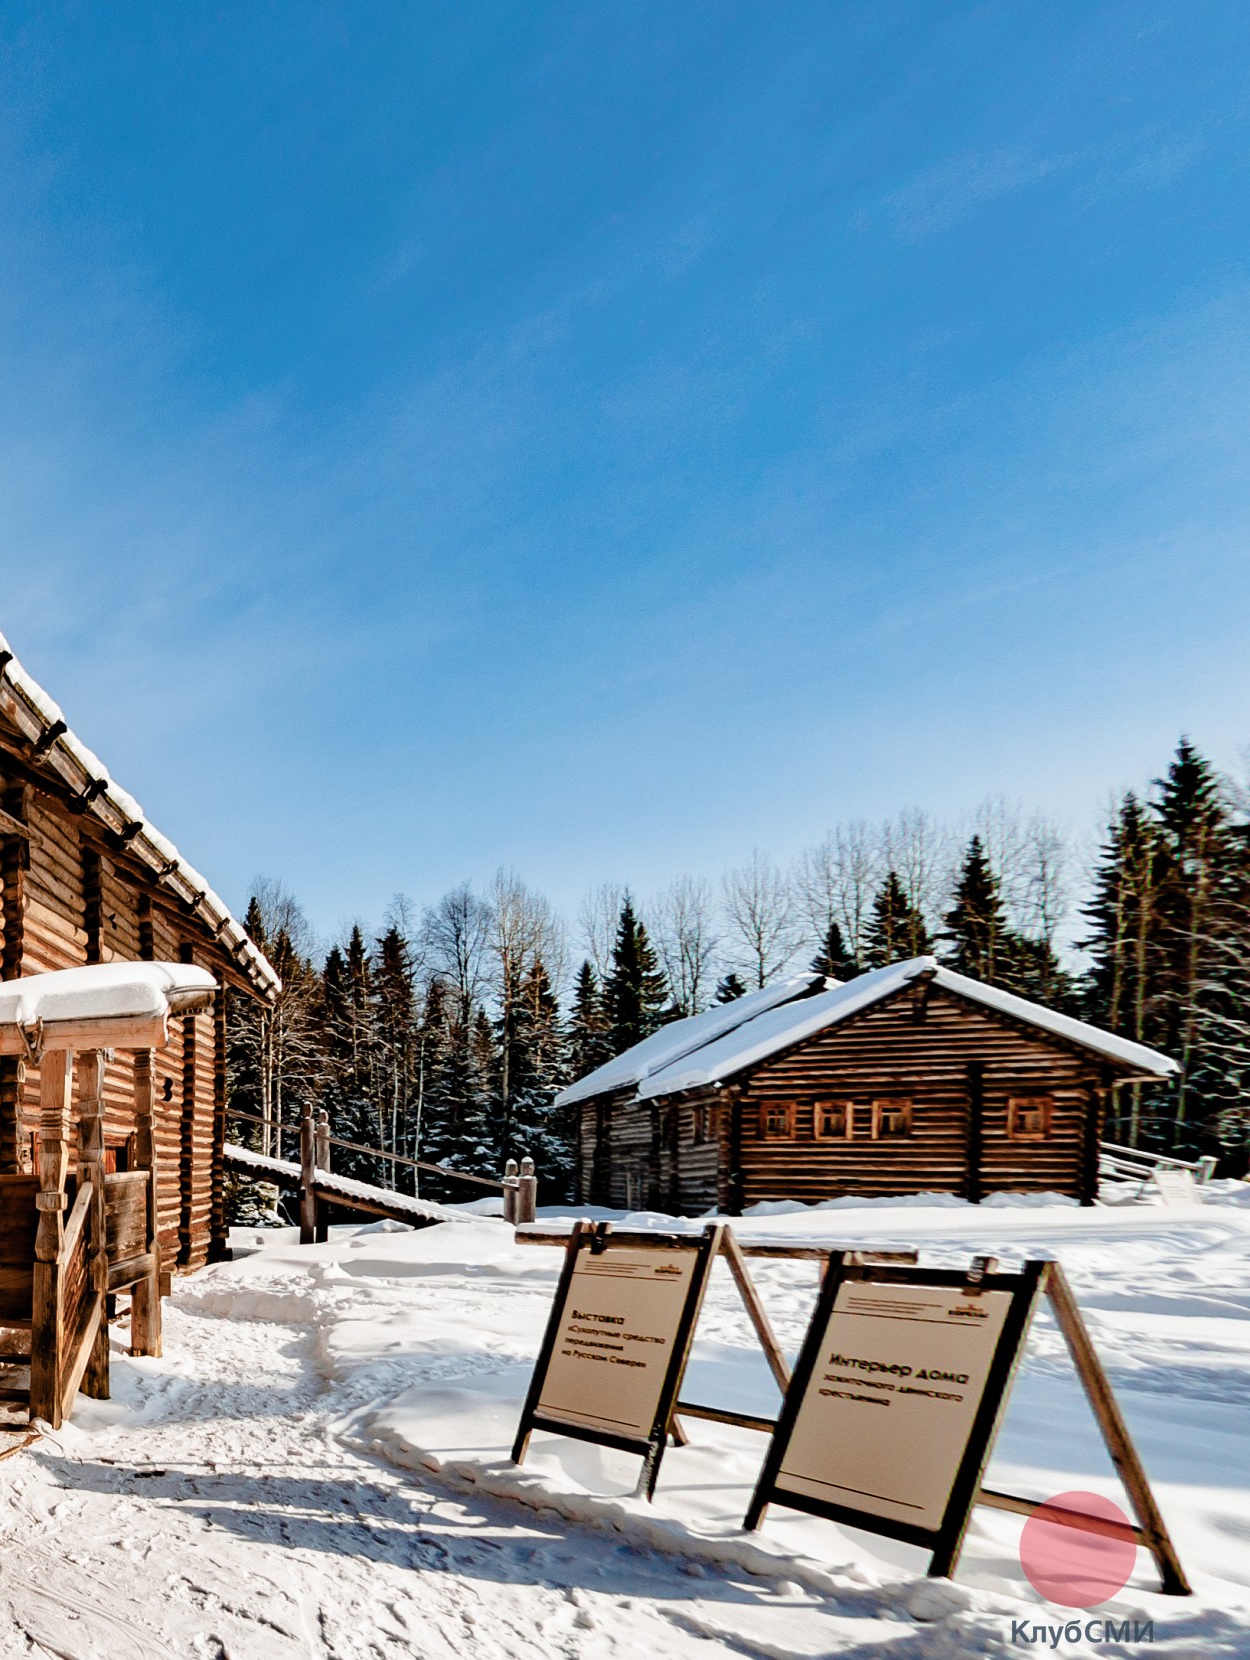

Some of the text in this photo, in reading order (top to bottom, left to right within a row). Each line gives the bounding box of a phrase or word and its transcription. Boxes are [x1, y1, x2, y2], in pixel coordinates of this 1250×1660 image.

[571, 1309, 625, 1325] Выставка
[622, 1333, 666, 1345] средства
[827, 1352, 970, 1385] Интерьер дома
